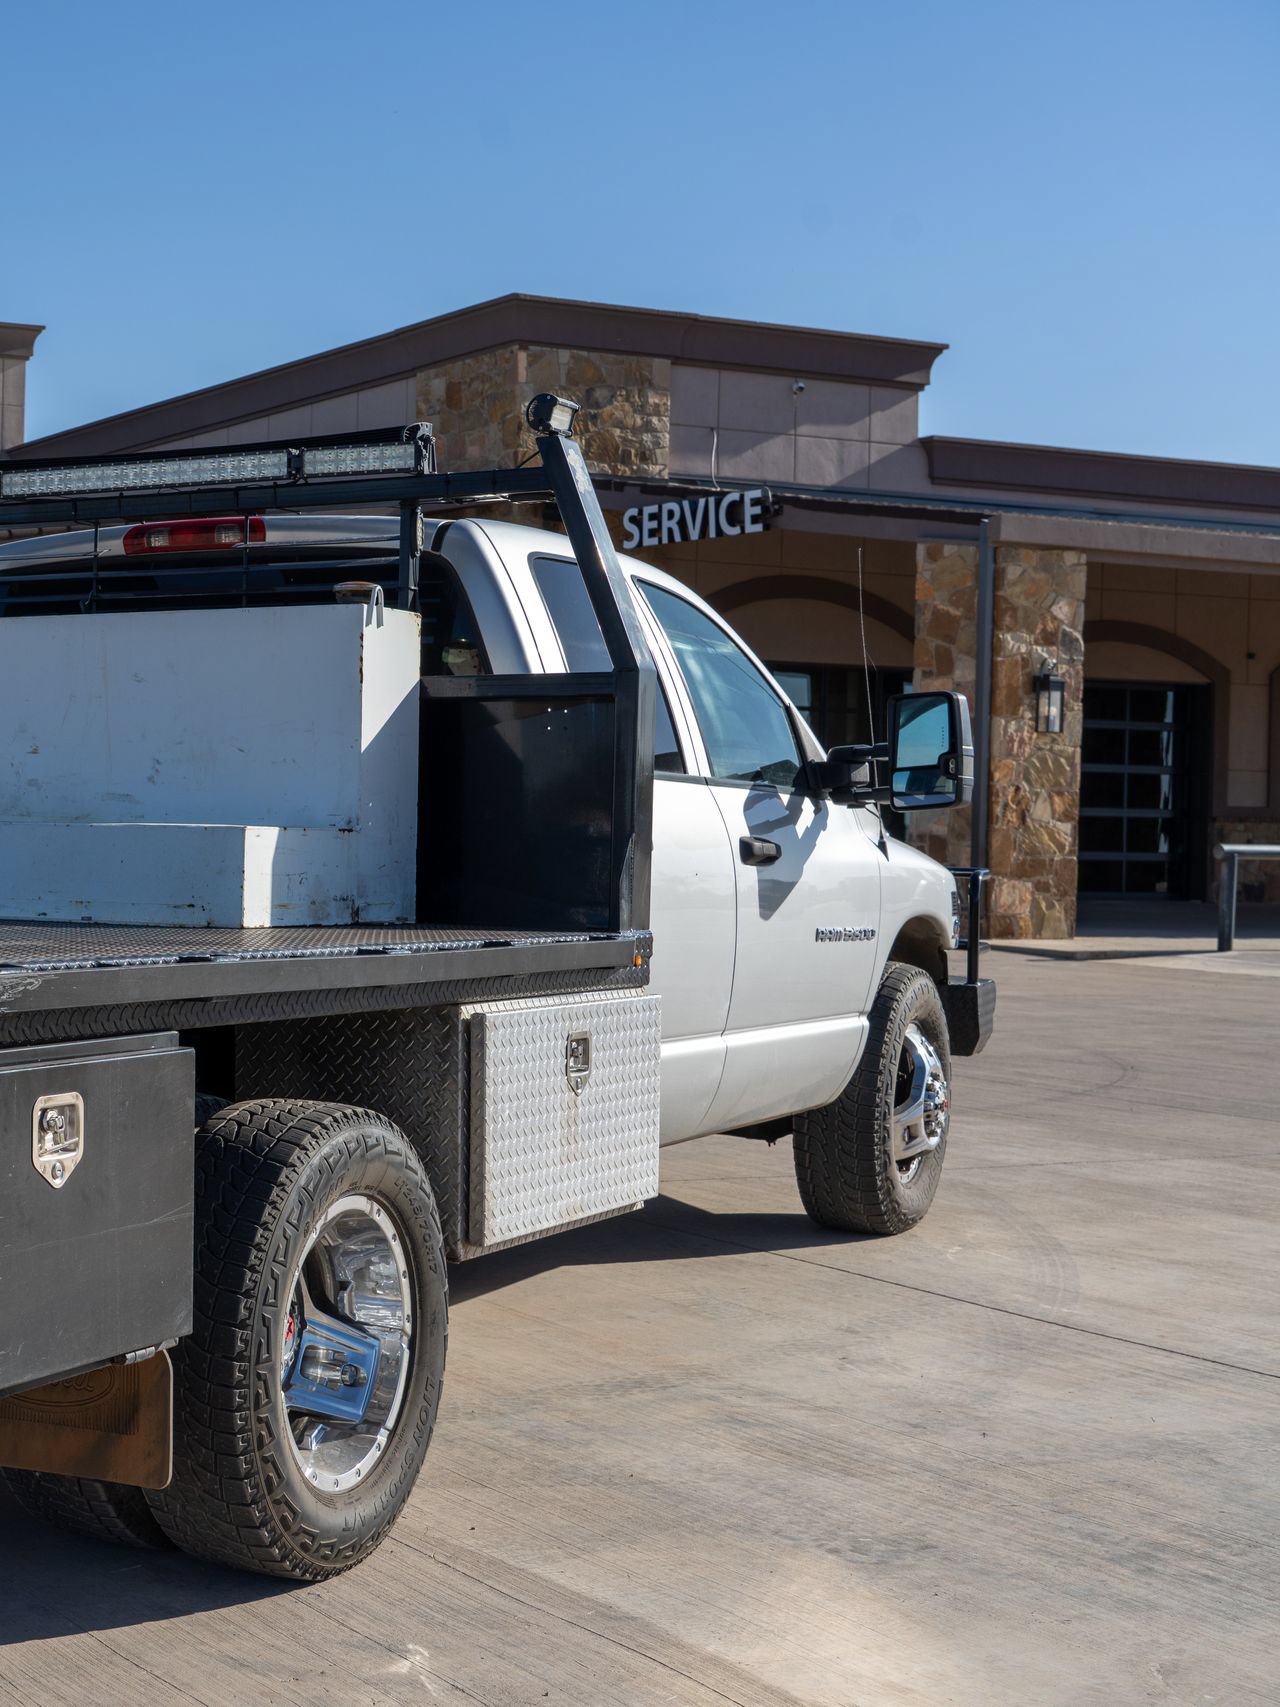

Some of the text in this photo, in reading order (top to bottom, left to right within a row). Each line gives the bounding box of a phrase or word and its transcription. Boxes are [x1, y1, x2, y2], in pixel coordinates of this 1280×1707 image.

[622, 489, 764, 550] SERVICE
[815, 928, 842, 942] RAM
[412, 1375, 436, 1449] LION
[373, 1447, 415, 1520] SPORT
